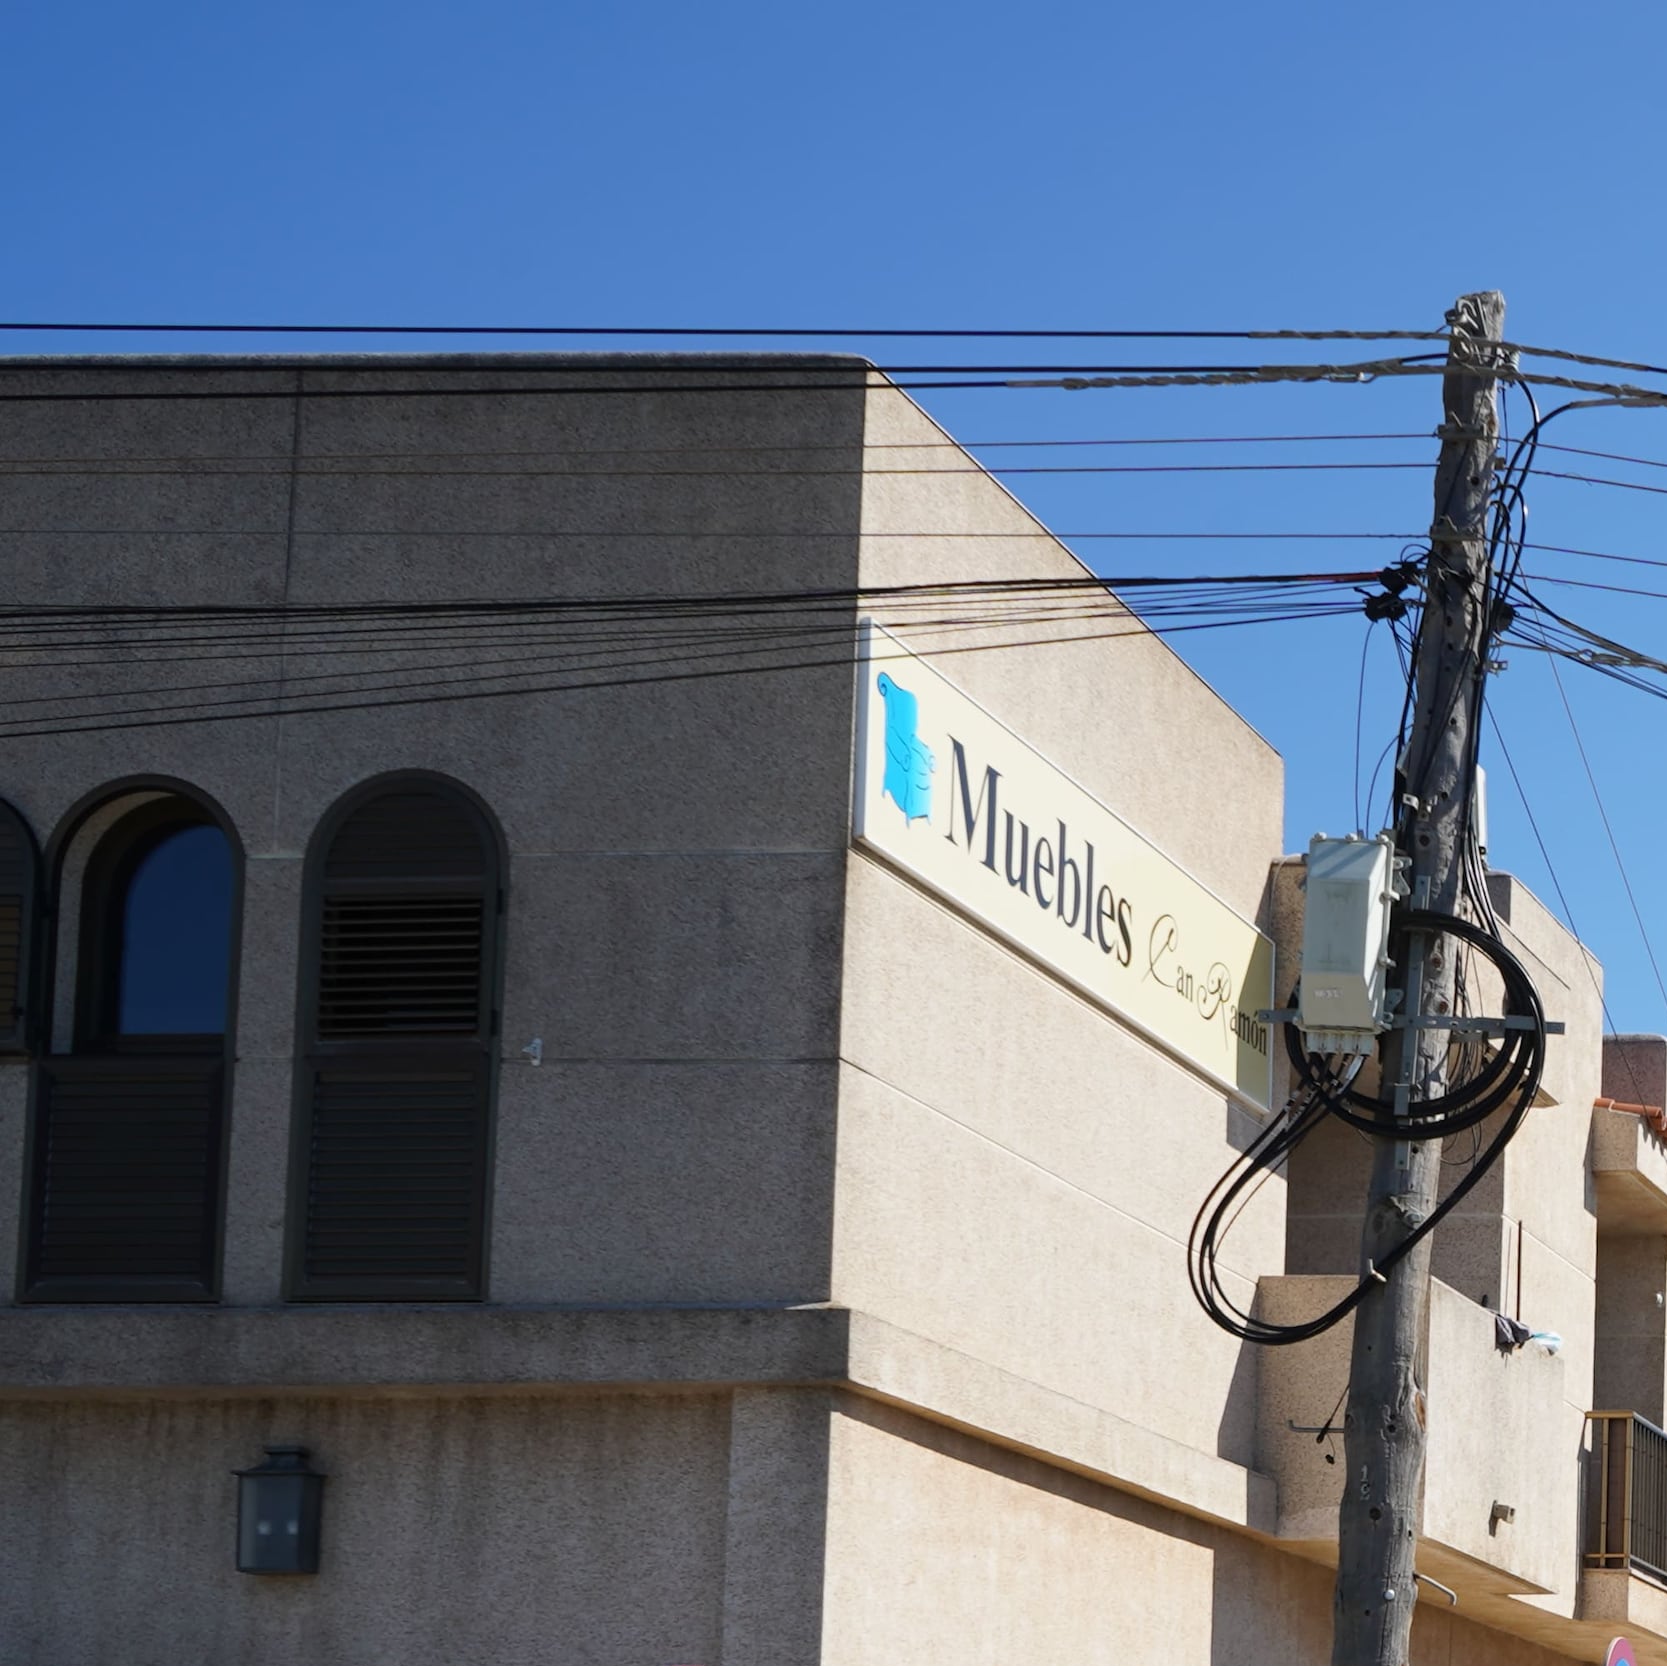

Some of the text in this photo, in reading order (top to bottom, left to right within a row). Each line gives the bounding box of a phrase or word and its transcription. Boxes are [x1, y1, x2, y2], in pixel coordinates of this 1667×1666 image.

[944, 734, 1268, 1056] Muebles Can Ramón
